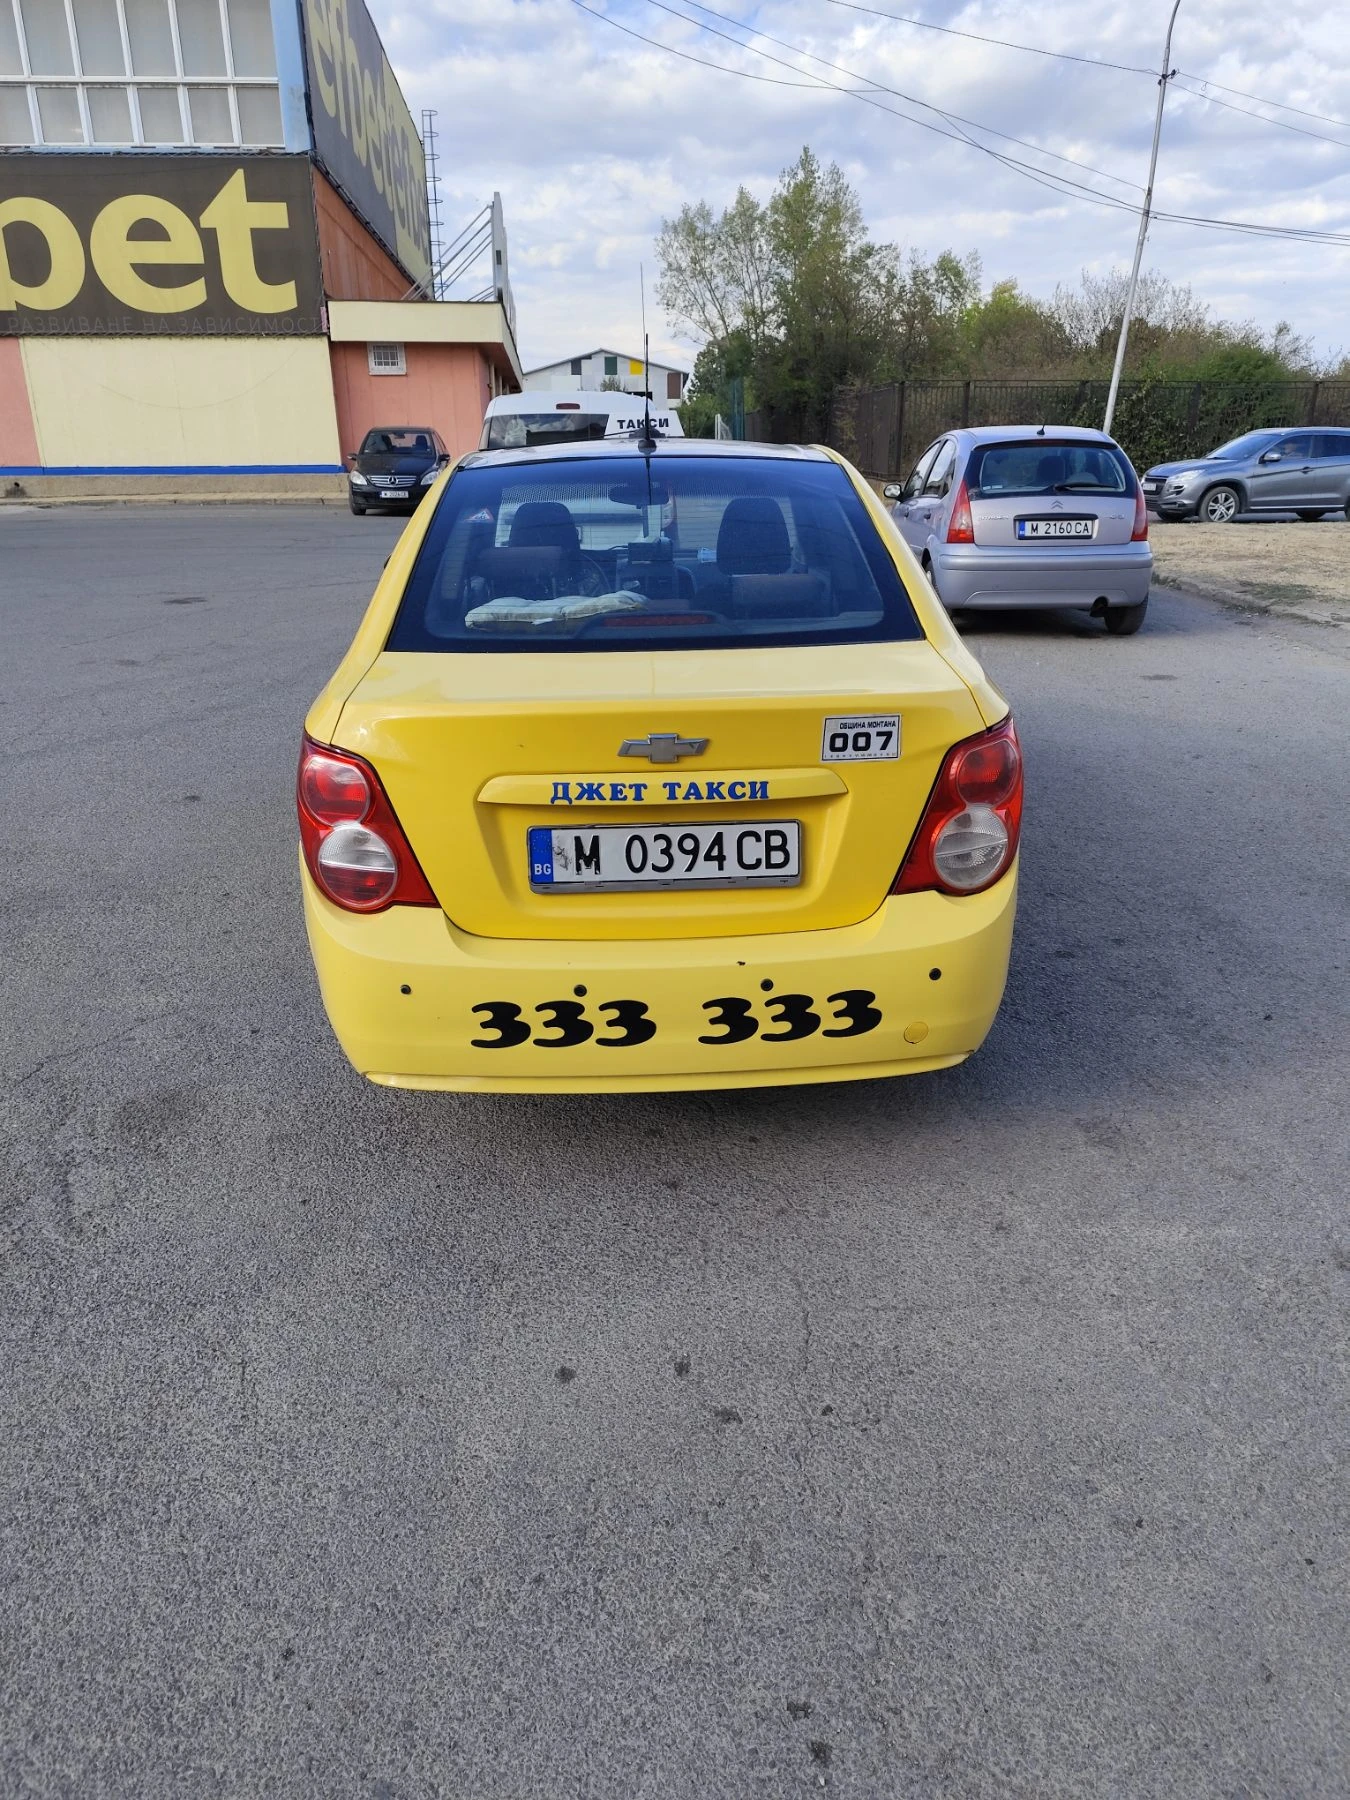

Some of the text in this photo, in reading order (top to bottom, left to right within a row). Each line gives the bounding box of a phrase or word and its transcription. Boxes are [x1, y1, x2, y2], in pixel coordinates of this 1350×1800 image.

[8, 316, 132, 331] РАЗВИВАНЕ
[142, 316, 169, 331] НА
[617, 418, 669, 429] ТАКСИ
[839, 720, 897, 730] ОБЩИНА МОНТАНА
[829, 731, 893, 752] 007
[550, 781, 769, 805] ДЖЕТ ТАКСИ
[573, 835, 601, 875] M
[534, 863, 551, 876] BG
[471, 989, 883, 1048] 333 333
